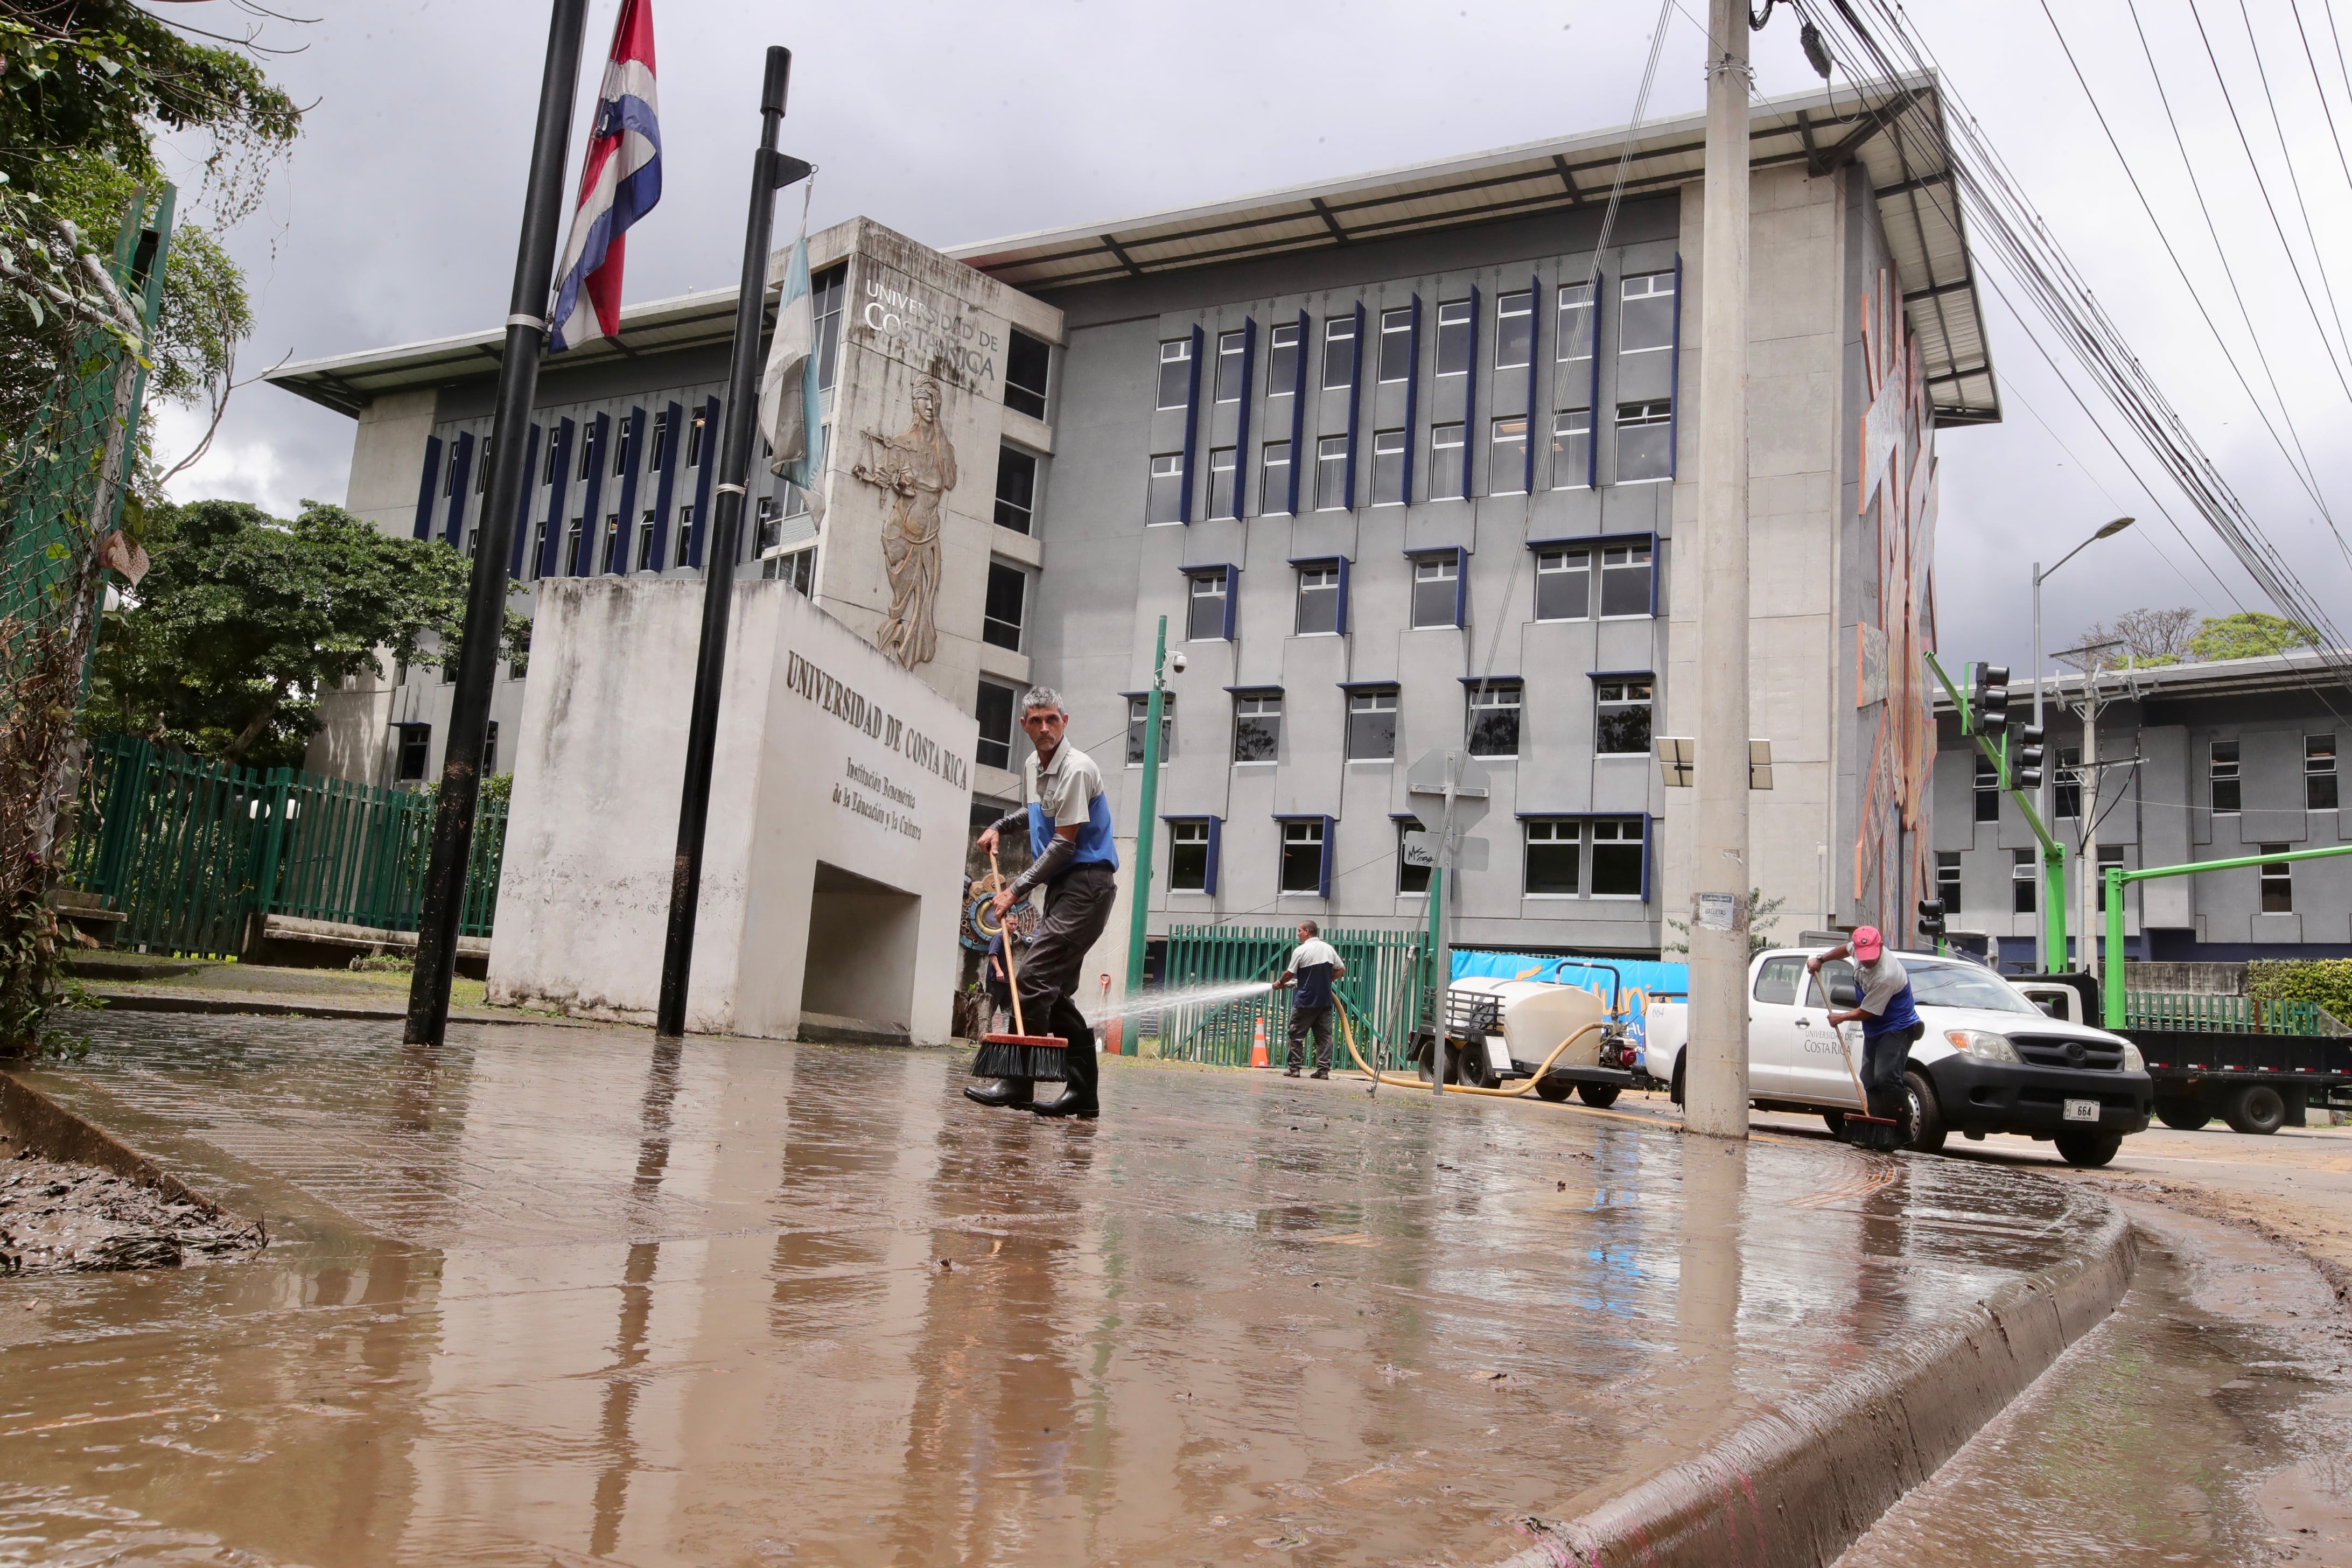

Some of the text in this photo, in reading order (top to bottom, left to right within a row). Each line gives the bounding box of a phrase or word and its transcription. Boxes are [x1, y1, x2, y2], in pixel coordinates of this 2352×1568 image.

[864, 302, 995, 381] COSTA RICA
[866, 279, 998, 352] UNIVERSIDAD DE
[787, 649, 968, 791] UNIVERSIDAD DE COSTA RICA
[846, 757, 915, 809] Institución Benemérita
[832, 782, 922, 841] de la Educación y la Cultura
[1652, 1007, 1665, 1018] 664
[1844, 1033, 1853, 1041] DE
[1804, 1039, 1830, 1054] COSTA
[2077, 1105, 2091, 1116] 664
